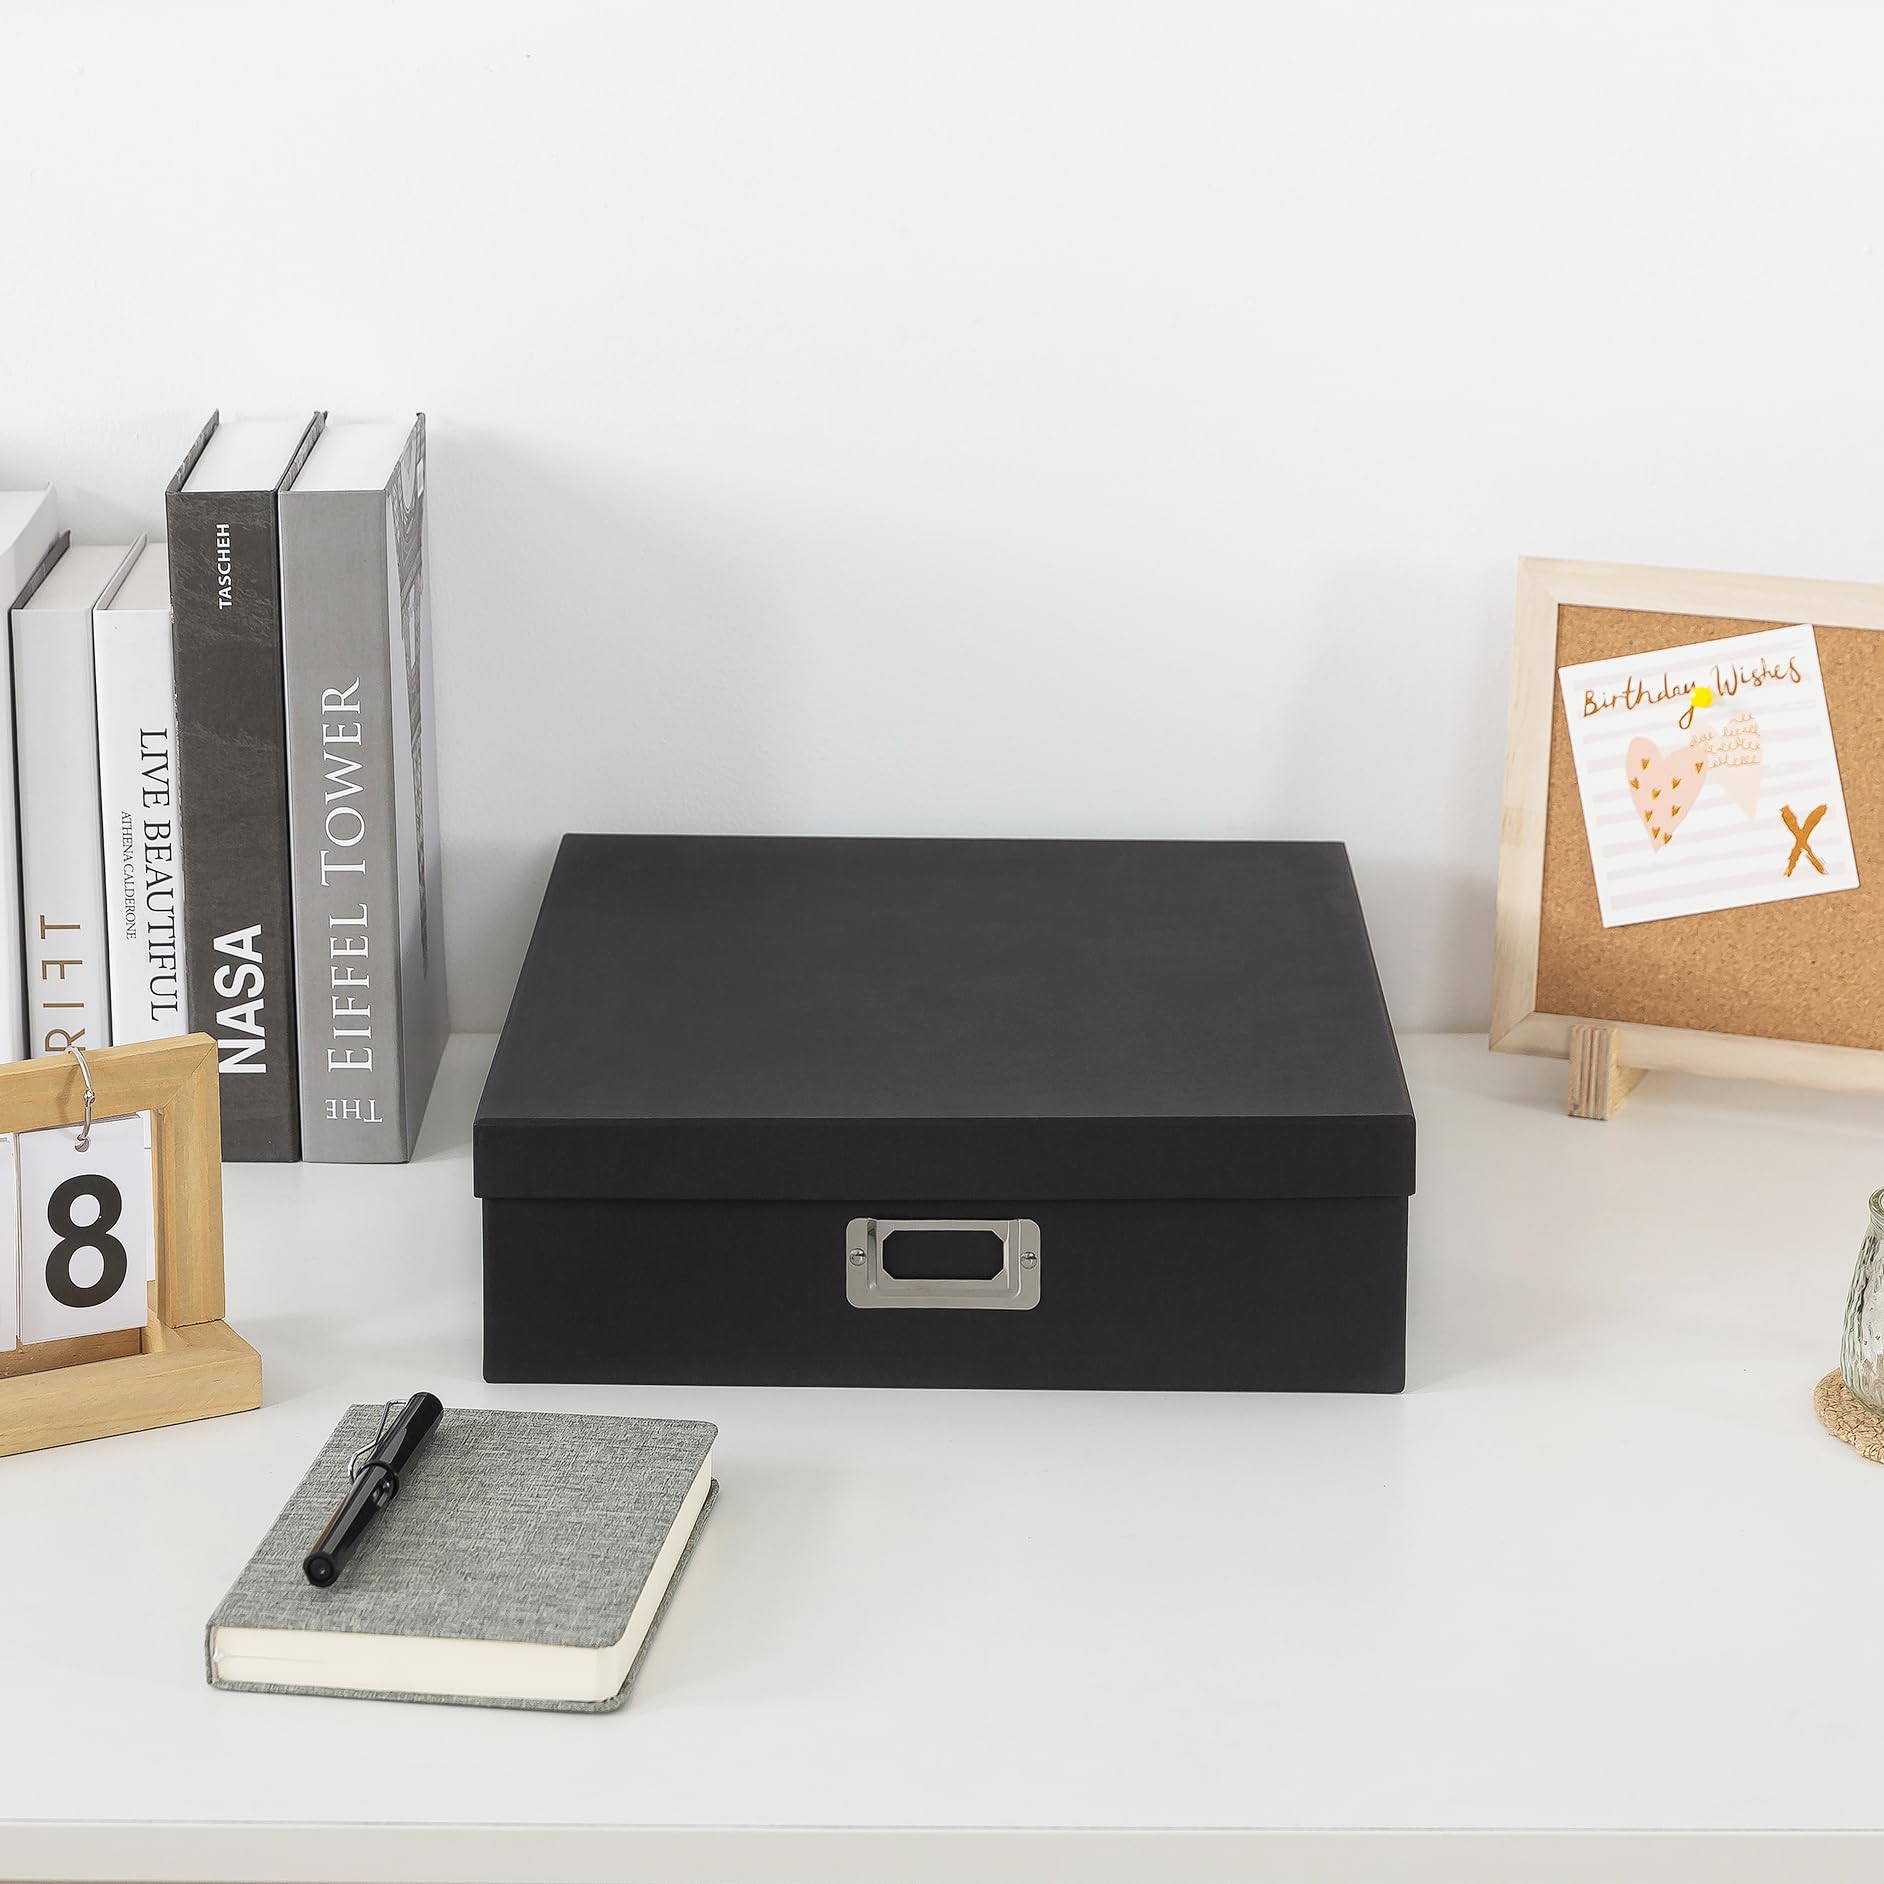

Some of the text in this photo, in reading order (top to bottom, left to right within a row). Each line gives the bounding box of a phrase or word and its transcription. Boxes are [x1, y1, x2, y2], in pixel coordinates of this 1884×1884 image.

[216, 523, 233, 610] TASCHEH
[1583, 655, 1802, 730] Birthday Wishes
[121, 810, 137, 940] ATHENA CALDERONE
[139, 728, 179, 1022] LIVE BEAUTIFUL
[319, 677, 383, 1123] THE EIFFEL TOWER
[213, 923, 268, 1074] NASA
[45, 1173, 128, 1309] 8
